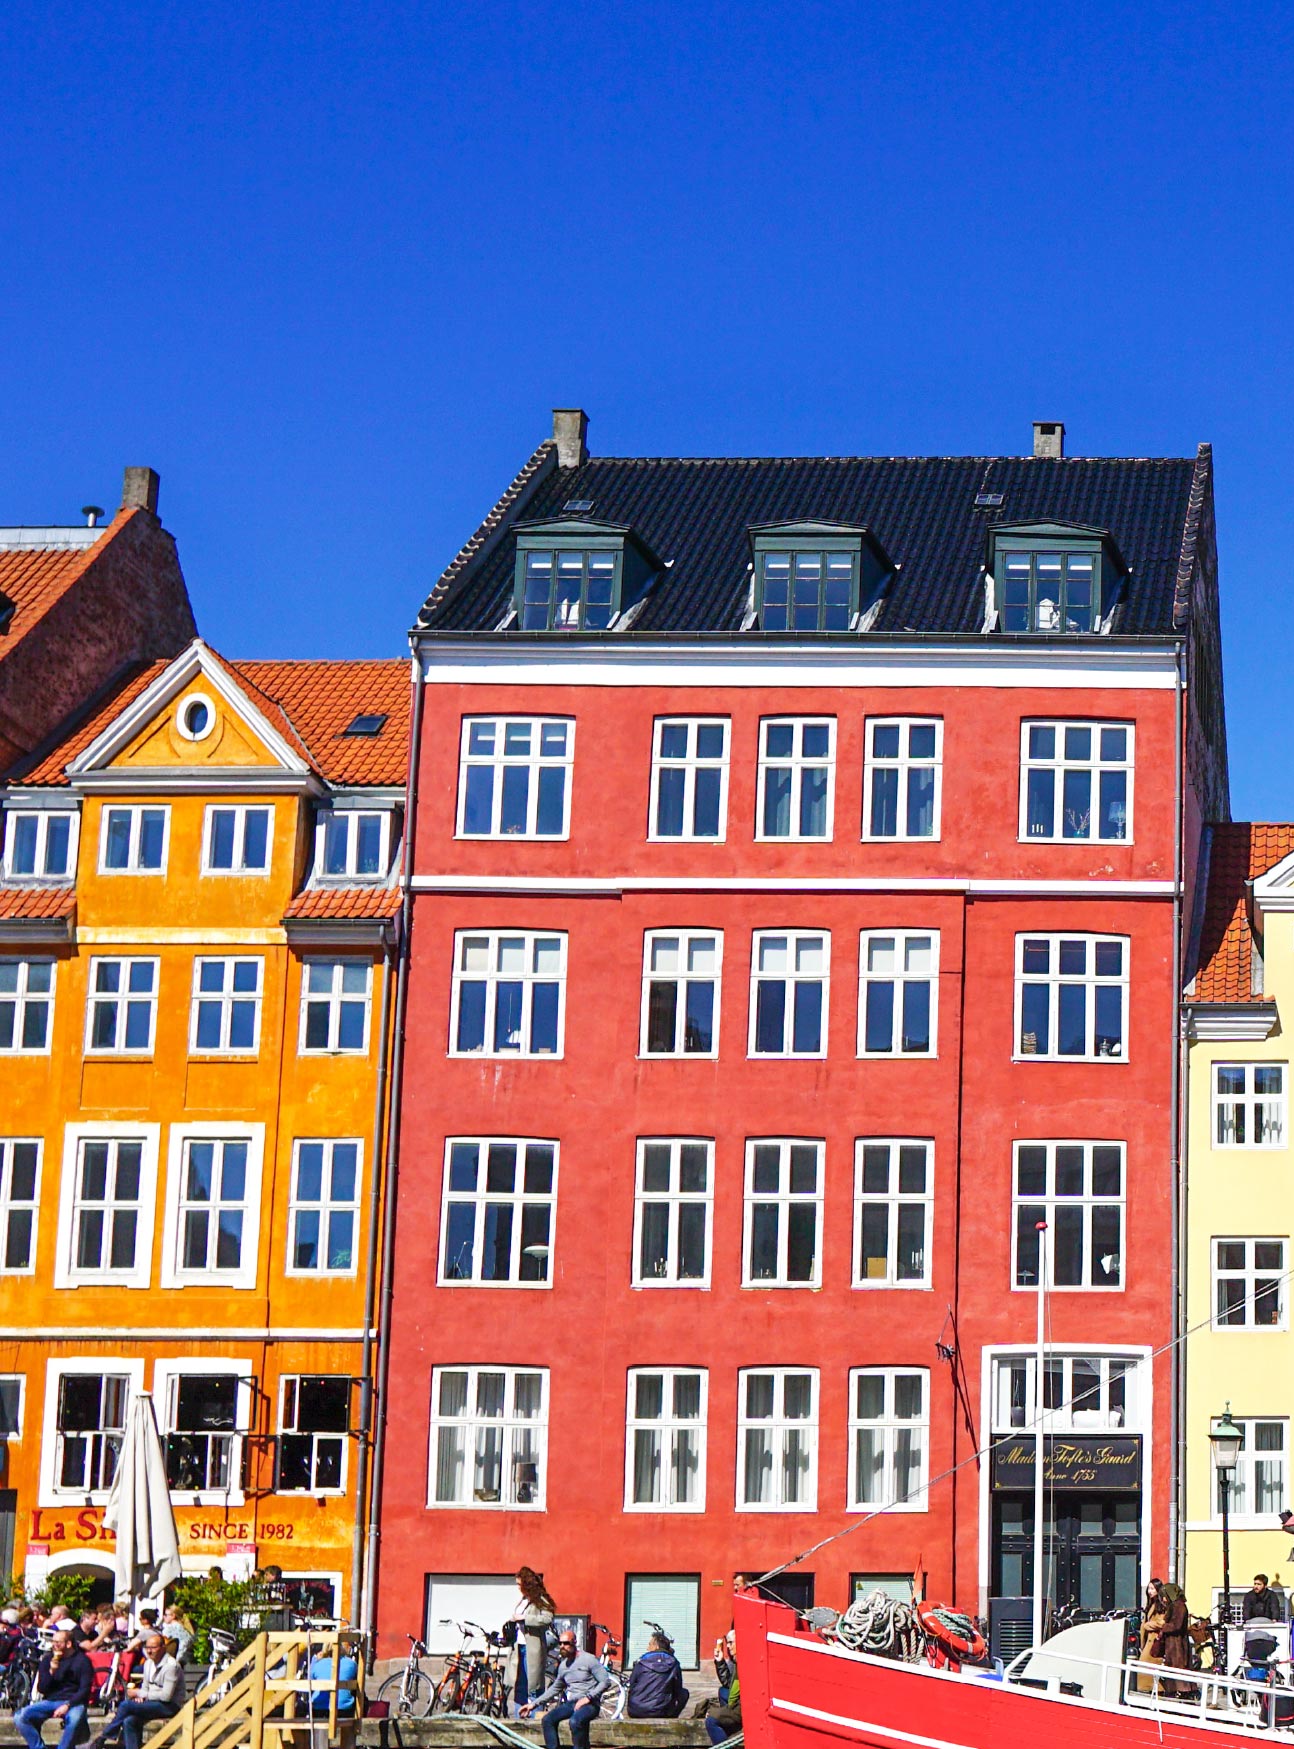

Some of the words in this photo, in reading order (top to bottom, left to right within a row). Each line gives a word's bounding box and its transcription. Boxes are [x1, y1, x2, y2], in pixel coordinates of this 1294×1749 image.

[30, 1510, 65, 1540] La
[189, 1523, 249, 1539] SINCE
[259, 1523, 294, 1540] 1982
